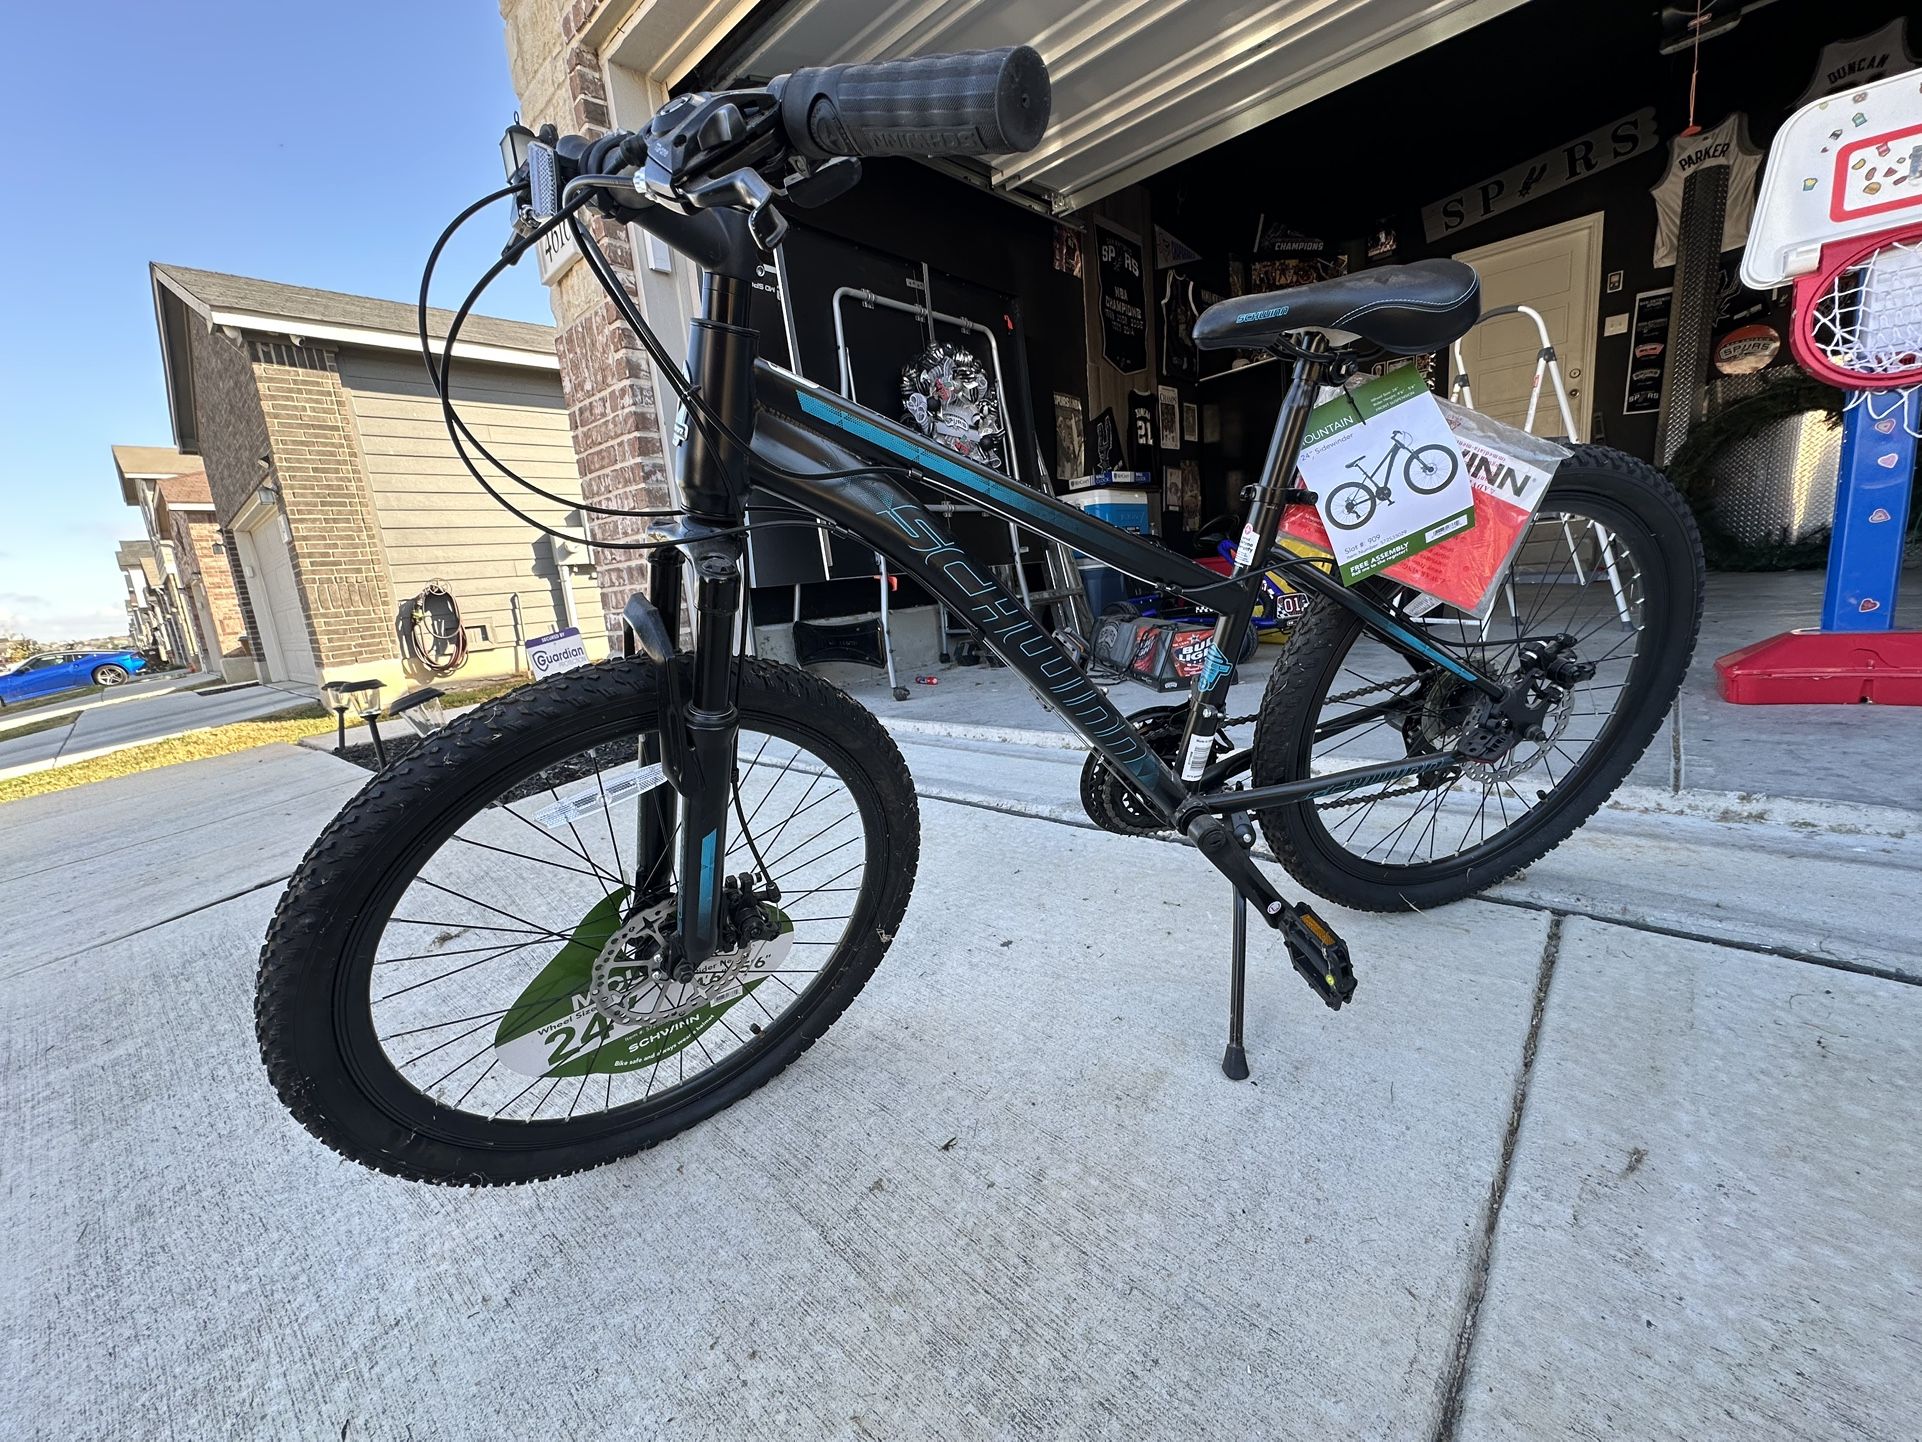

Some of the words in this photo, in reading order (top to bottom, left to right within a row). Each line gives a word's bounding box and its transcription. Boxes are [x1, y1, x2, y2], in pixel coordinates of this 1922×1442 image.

[1826, 54, 1889, 85] DUNCAN
[1678, 142, 1731, 172] PARKER
[1275, 242, 1324, 251] CHAMPIONS
[1722, 342, 1771, 356] SPURS
[1137, 420, 1154, 446] 21
[1301, 415, 1354, 446] OUNTAIN
[1344, 544, 1359, 554] Slot
[1367, 534, 1381, 543] 909
[1350, 562, 1370, 573] FREE
[1371, 541, 1409, 563] ASSEMBLY
[1284, 597, 1301, 612] 01
[537, 646, 584, 666] Guardian
[537, 1015, 573, 1036] Wheel
[628, 1013, 700, 1053] SCHWINN
[629, 1057, 642, 1065] safe
[643, 1052, 656, 1061] and
[656, 1043, 677, 1056] always
[677, 1034, 692, 1045] wear
[696, 1014, 715, 1031] helmet
